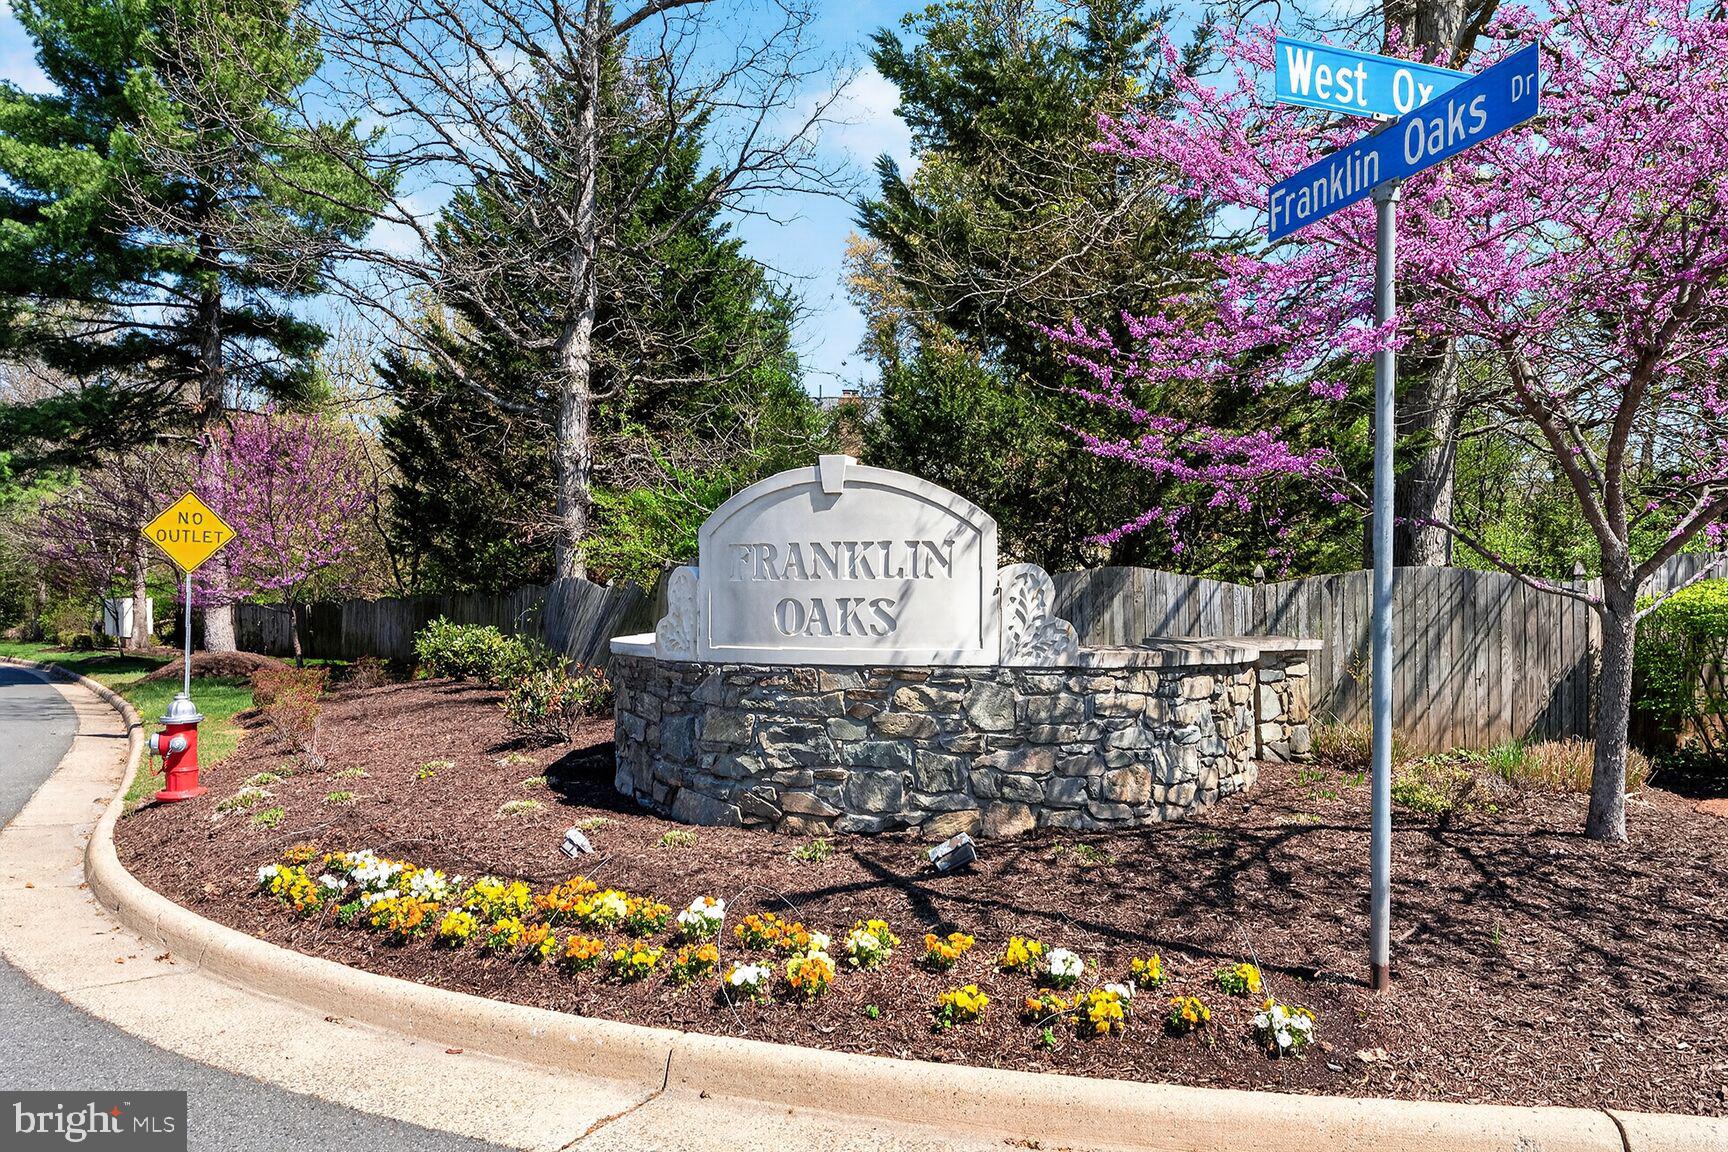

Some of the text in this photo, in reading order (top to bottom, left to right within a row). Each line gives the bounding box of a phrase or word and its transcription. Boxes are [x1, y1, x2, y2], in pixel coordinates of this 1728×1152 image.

[1285, 45, 1434, 114] West Ox
[1270, 72, 1535, 232] Franklin Oaks Dr
[156, 529, 223, 543] OUTLET
[178, 511, 203, 526] NO
[728, 539, 956, 581] FRANKLIN
[773, 597, 898, 637] OAKS
